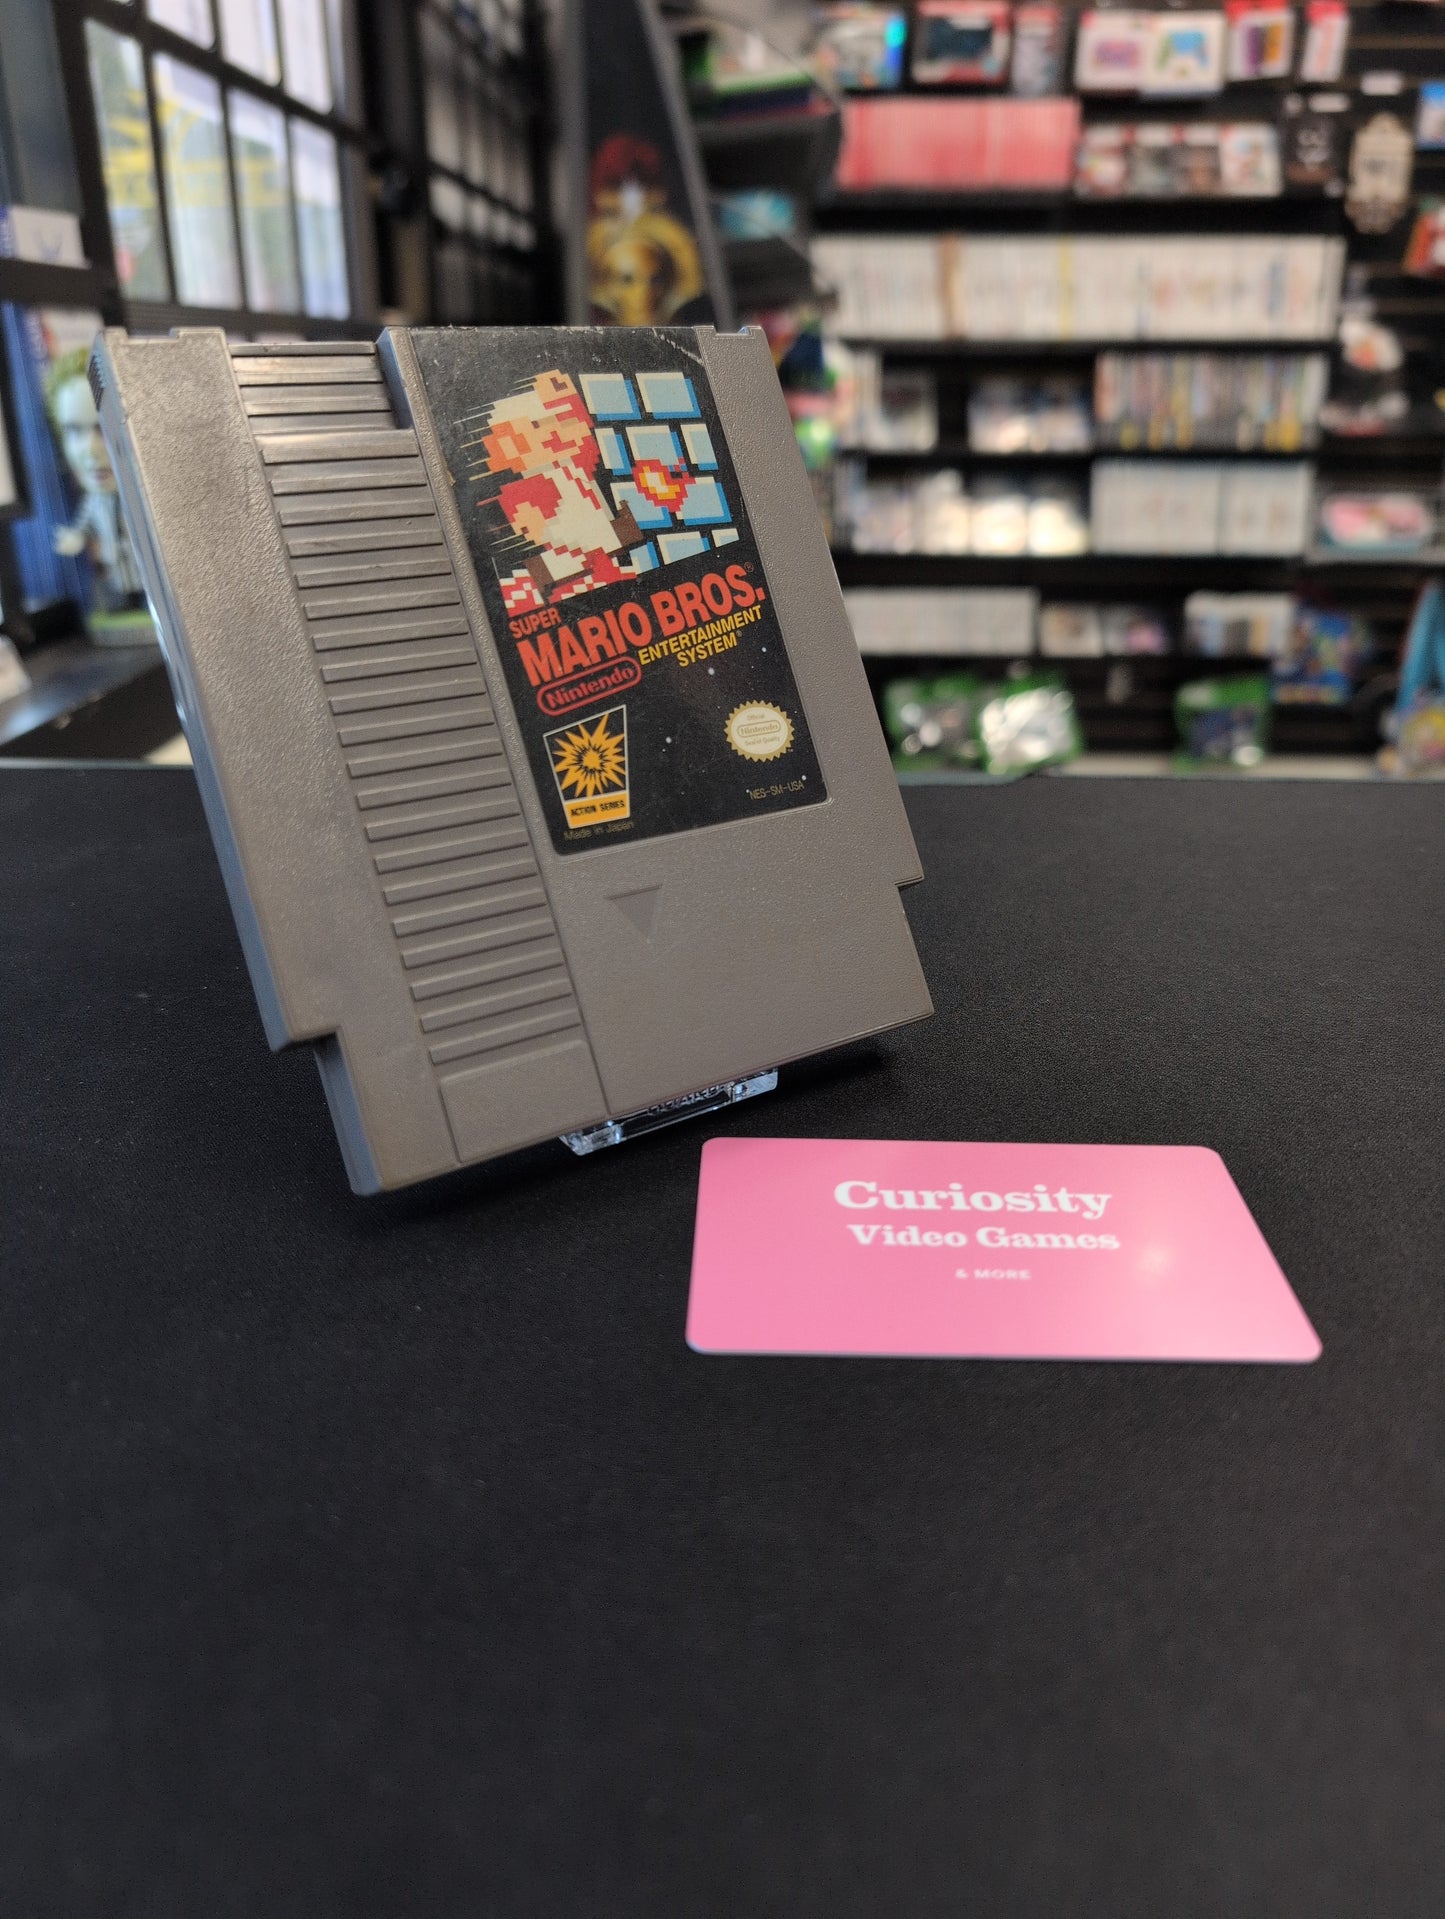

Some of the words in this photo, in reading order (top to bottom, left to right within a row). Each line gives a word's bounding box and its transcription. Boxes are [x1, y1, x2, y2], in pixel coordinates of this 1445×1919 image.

[509, 607, 561, 639] SUPER
[516, 602, 653, 687] MARIO
[650, 564, 766, 637] BROS.
[638, 605, 762, 665] ENTERTAINMENT
[676, 632, 738, 667] SYSTEM
[545, 667, 635, 709] Nintendo
[600, 800, 625, 811] SERIES
[750, 780, 805, 800] NES-SM-USA
[834, 1180, 1112, 1220] Curiosity
[847, 1224, 968, 1248] Video
[976, 1226, 1121, 1250] Games
[955, 1268, 968, 1279] &
[974, 1269, 1032, 1280] MORE
